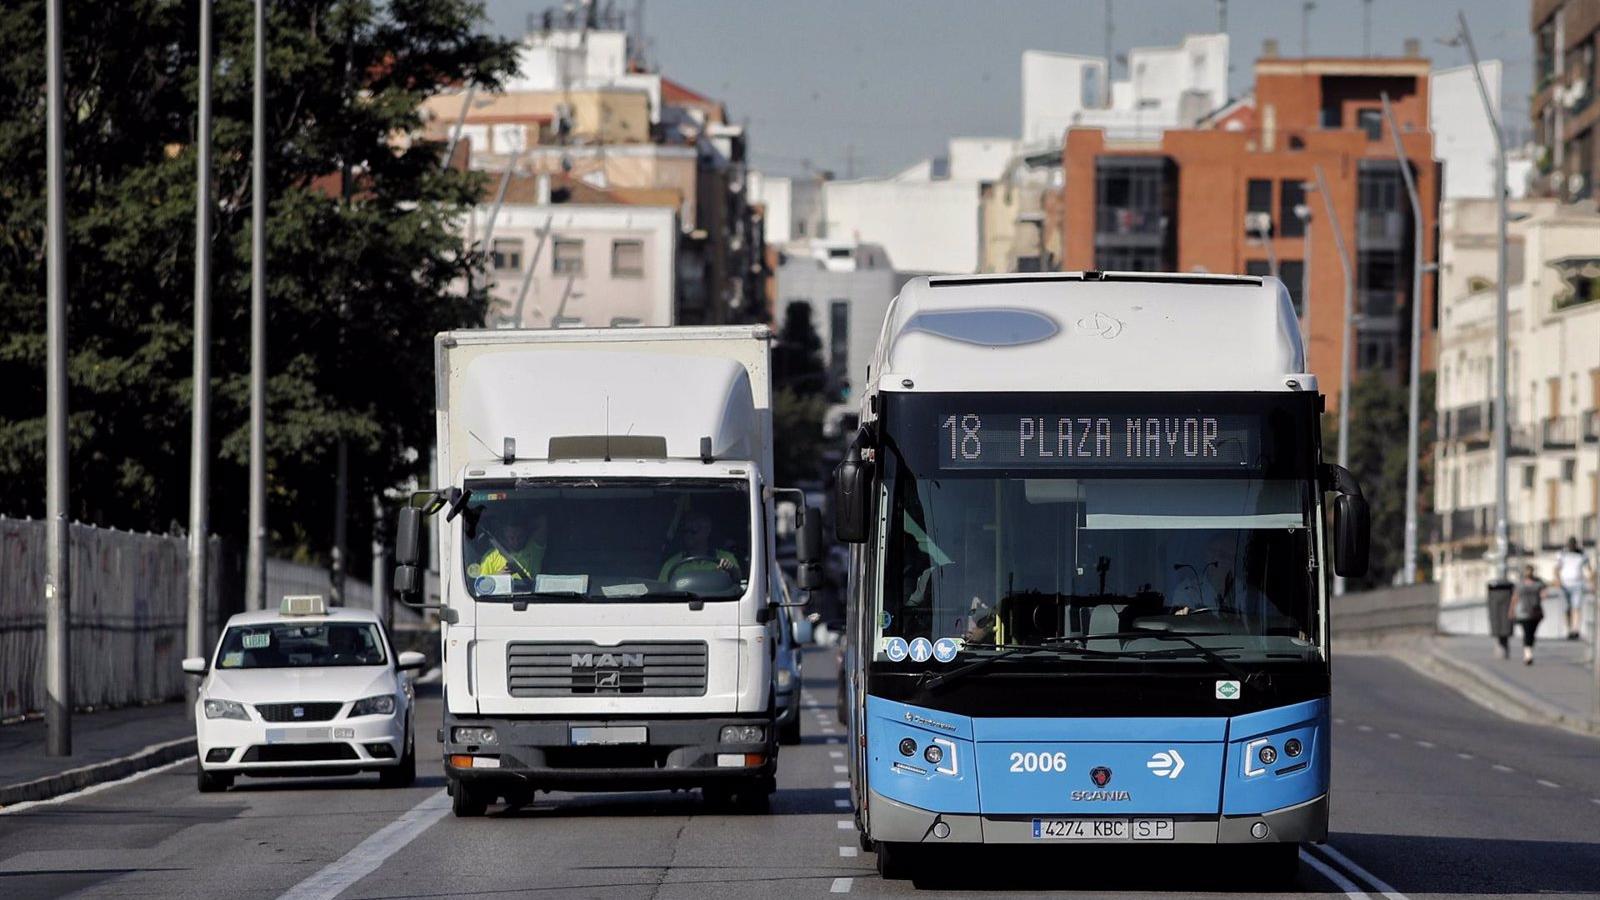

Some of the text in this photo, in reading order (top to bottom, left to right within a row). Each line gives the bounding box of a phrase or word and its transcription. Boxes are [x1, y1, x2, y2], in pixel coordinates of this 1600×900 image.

[942, 413, 1217, 459] 18 PLAZA MAYOR
[571, 653, 644, 667] MAN
[1009, 752, 1067, 773] 2006
[1071, 791, 1131, 801] SCANIA
[1045, 821, 1084, 836] 4274
[1093, 820, 1123, 836] KBC
